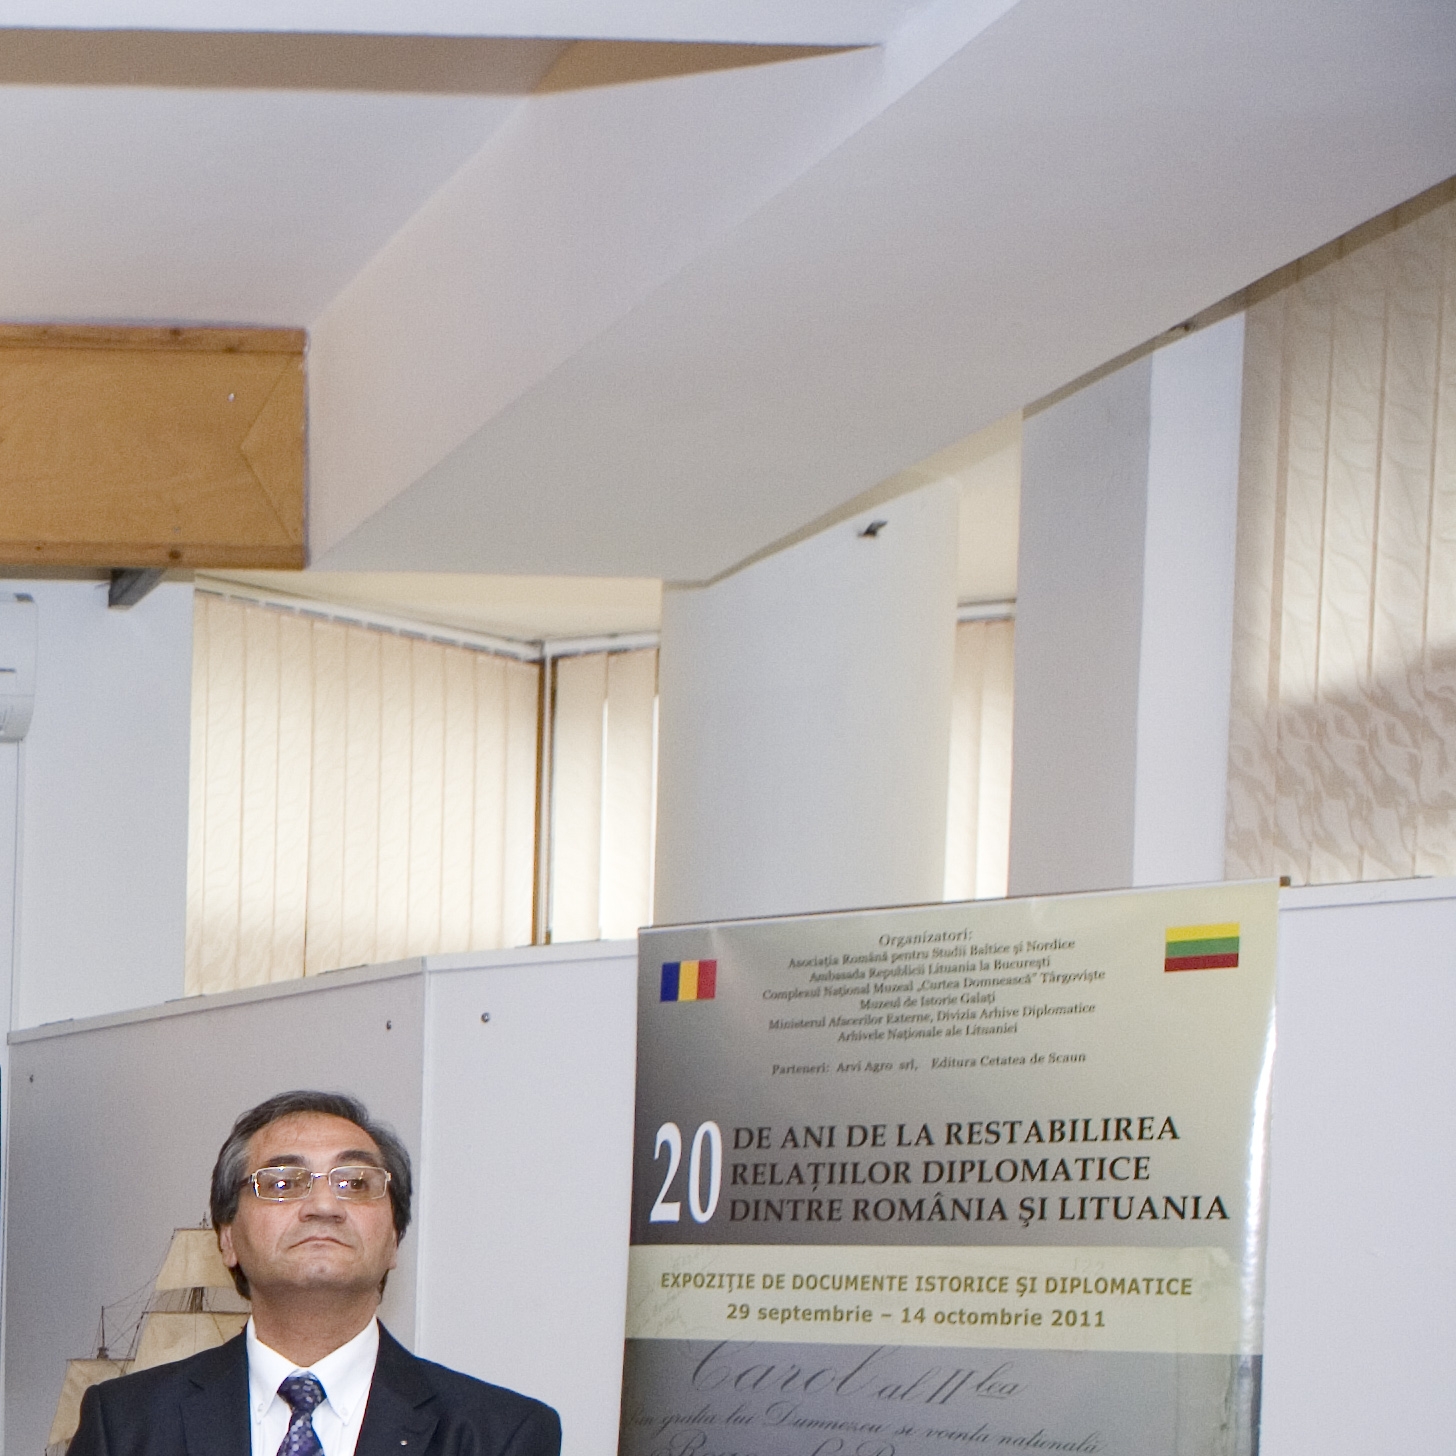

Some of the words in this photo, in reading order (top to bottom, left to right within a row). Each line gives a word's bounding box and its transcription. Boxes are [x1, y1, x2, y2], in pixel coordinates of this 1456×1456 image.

[878, 927, 974, 949] Organizatori:
[891, 949, 929, 963] pentru
[931, 946, 966, 959] Studii
[1026, 938, 1075, 952] Nordice
[928, 960, 976, 975] Lituania
[979, 959, 990, 971] la
[873, 981, 914, 995] Muzeal
[769, 1016, 826, 1030] Ministerul
[828, 1014, 883, 1028] Afacerilor
[937, 1008, 977, 1022] Divizia
[979, 1006, 1019, 1020] Arhive
[1022, 1002, 1096, 1019] Diplomatice
[860, 998, 901, 1011] Muzeul
[903, 997, 918, 1008] de
[838, 1028, 886, 1042] Arhivele
[944, 1024, 962, 1037] ale
[771, 1062, 831, 1076] Parteneri:
[837, 1059, 861, 1073] Arvi
[931, 1056, 976, 1069] Editura
[979, 1054, 1026, 1067] Cetatea
[1029, 1052, 1045, 1064] de
[1048, 1051, 1086, 1064] Scaun
[649, 1120, 723, 1225] 20
[732, 1126, 772, 1150] DE
[780, 1125, 837, 1149] ANI
[846, 1124, 886, 1148] DE
[896, 1122, 935, 1147] LA
[944, 1116, 1181, 1146] RESTABILIREA
[922, 1156, 1151, 1184] DIPLOMATICE
[729, 1198, 842, 1222] DINTRE
[852, 1191, 1008, 1222] ROMÂNIA
[1058, 1194, 1230, 1221] LITUANIA
[762, 1273, 785, 1291] DE
[791, 1273, 909, 1292] DOCUMENTE
[915, 1275, 1010, 1294] ISTORICE
[1044, 1276, 1193, 1296] DIPLOMATICE
[726, 1302, 750, 1320] 29
[757, 1303, 874, 1325] septembrie
[901, 1307, 926, 1324] 14
[933, 1307, 1043, 1327] octombrie
[1051, 1309, 1106, 1328] 2011
